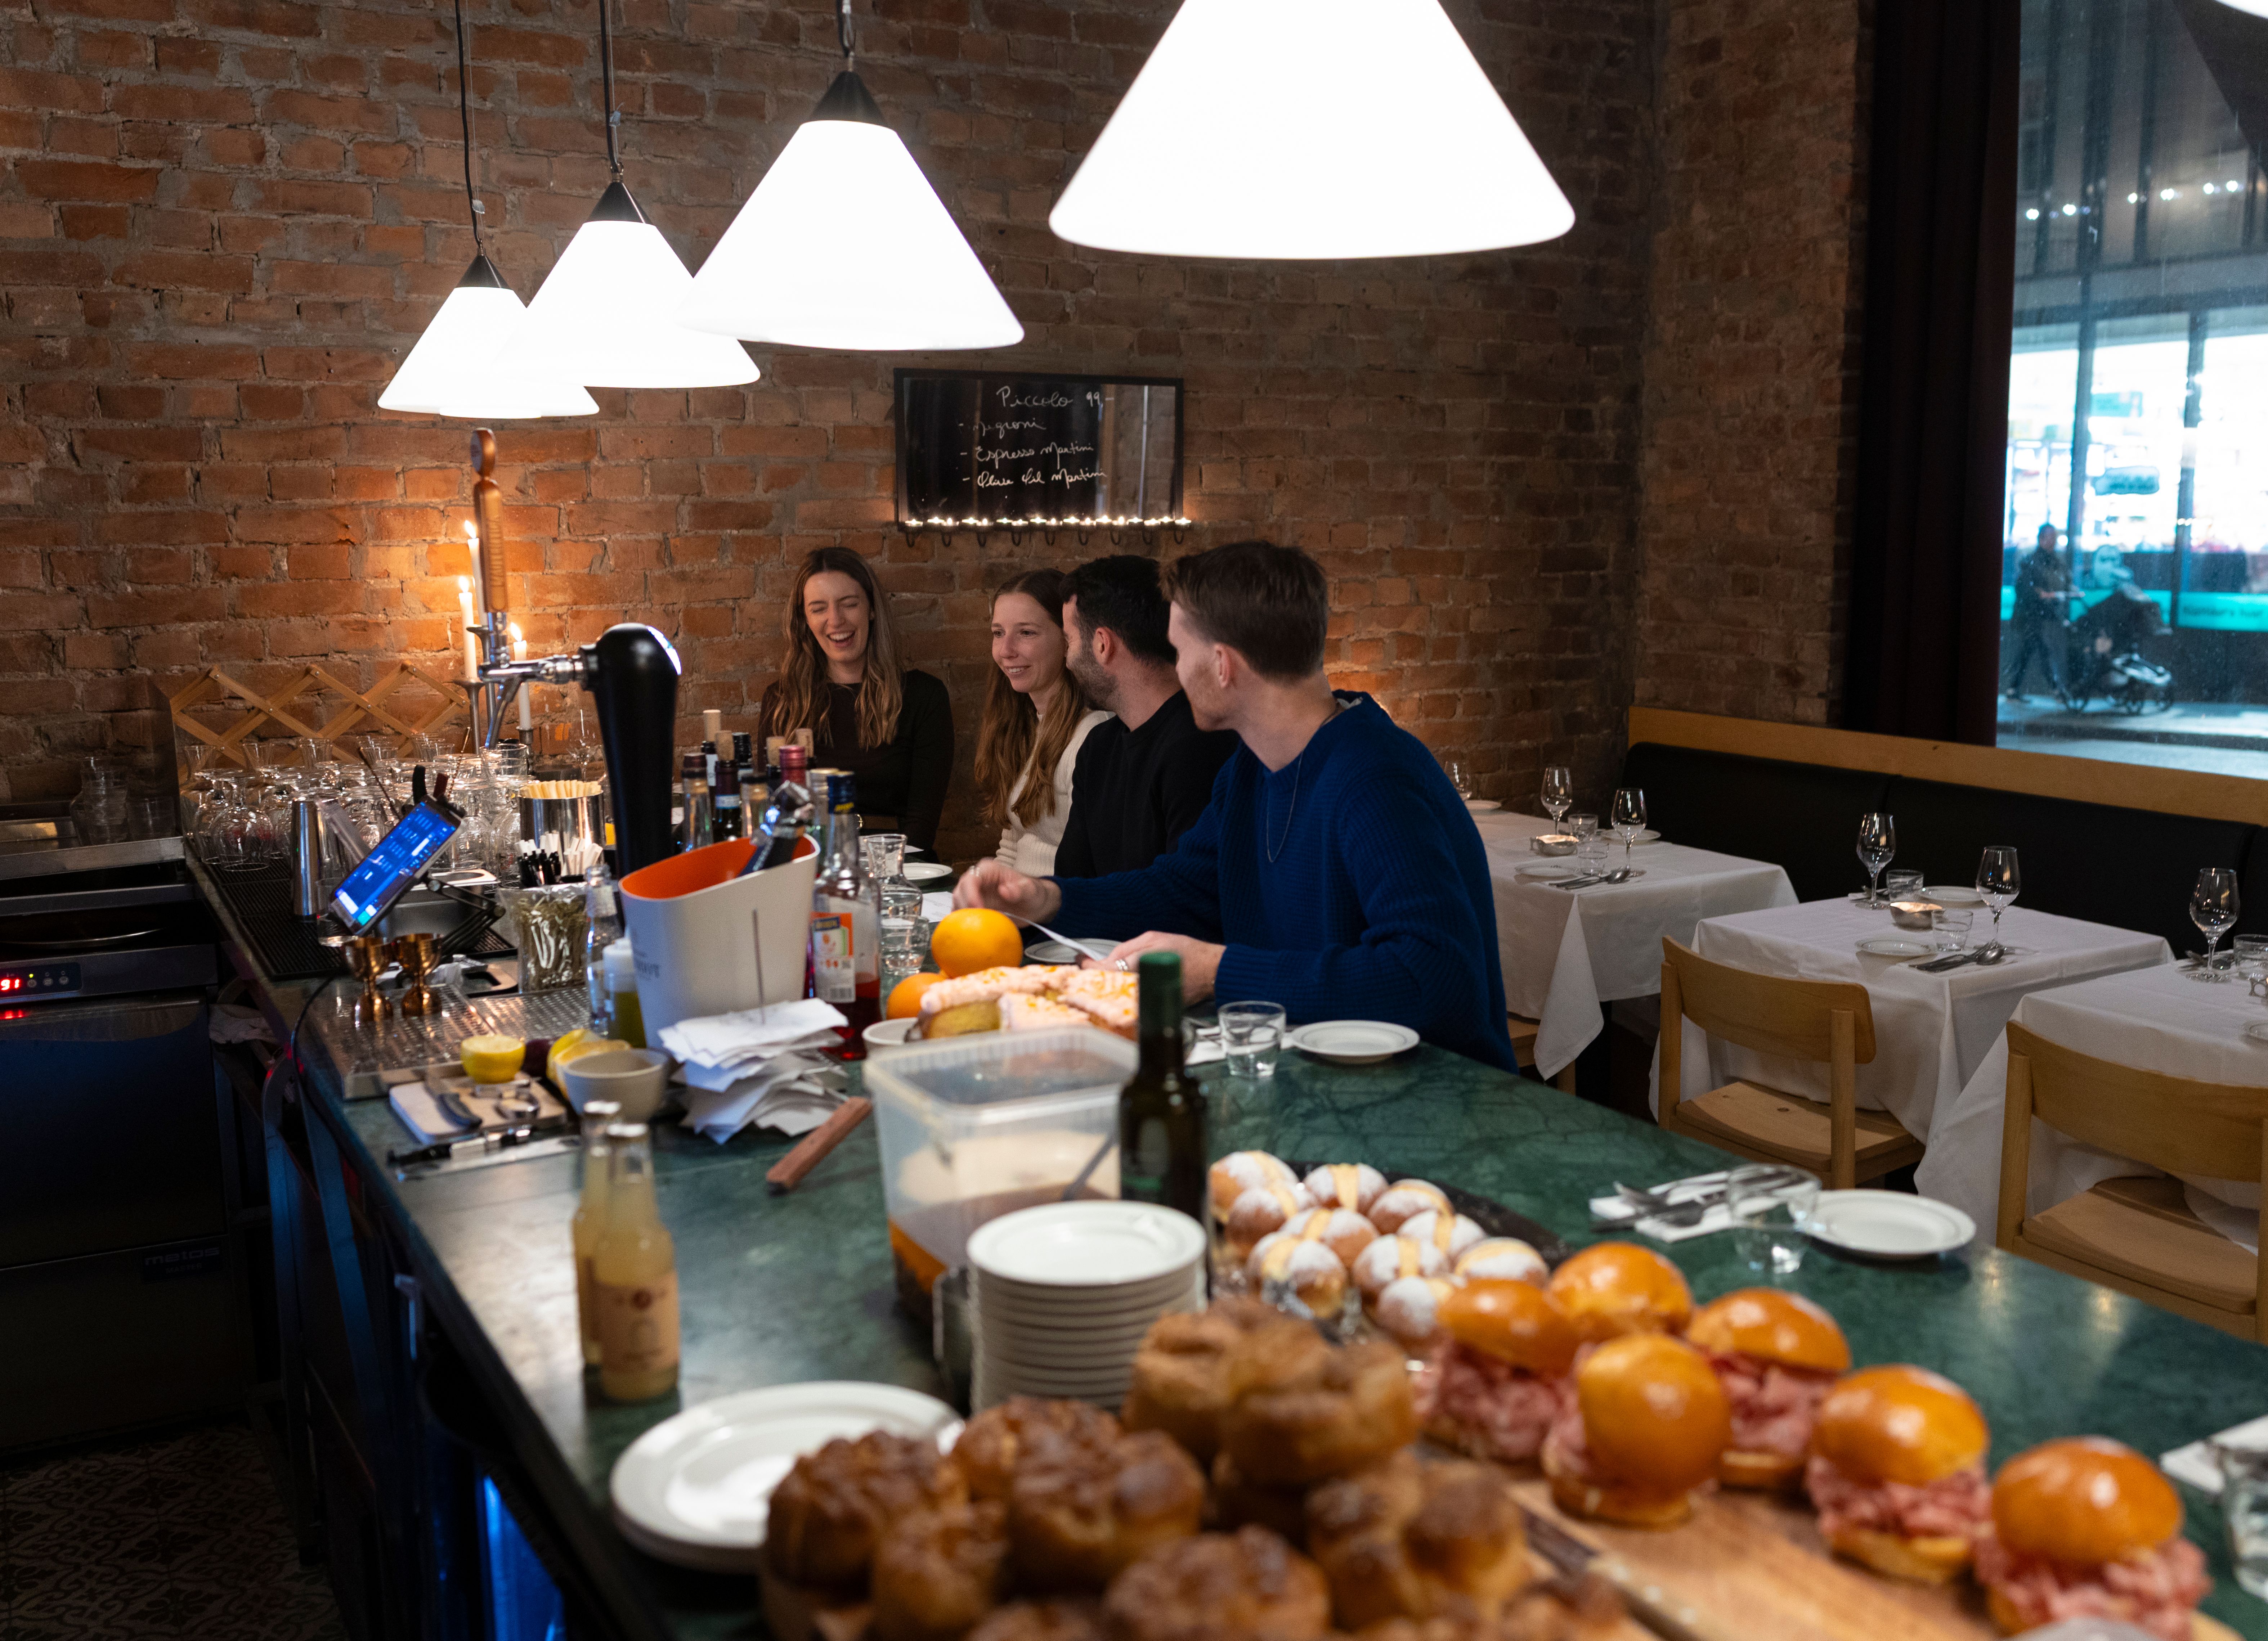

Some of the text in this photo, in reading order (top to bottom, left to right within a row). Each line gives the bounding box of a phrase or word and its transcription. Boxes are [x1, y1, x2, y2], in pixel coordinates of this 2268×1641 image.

[996, 385, 1074, 407] Piccolo
[975, 441, 1094, 469] Espresso Martini
[977, 468, 1107, 489] Olive Oil Martini
[144, 1247, 219, 1266] metos
[165, 1263, 202, 1274] MASTER
